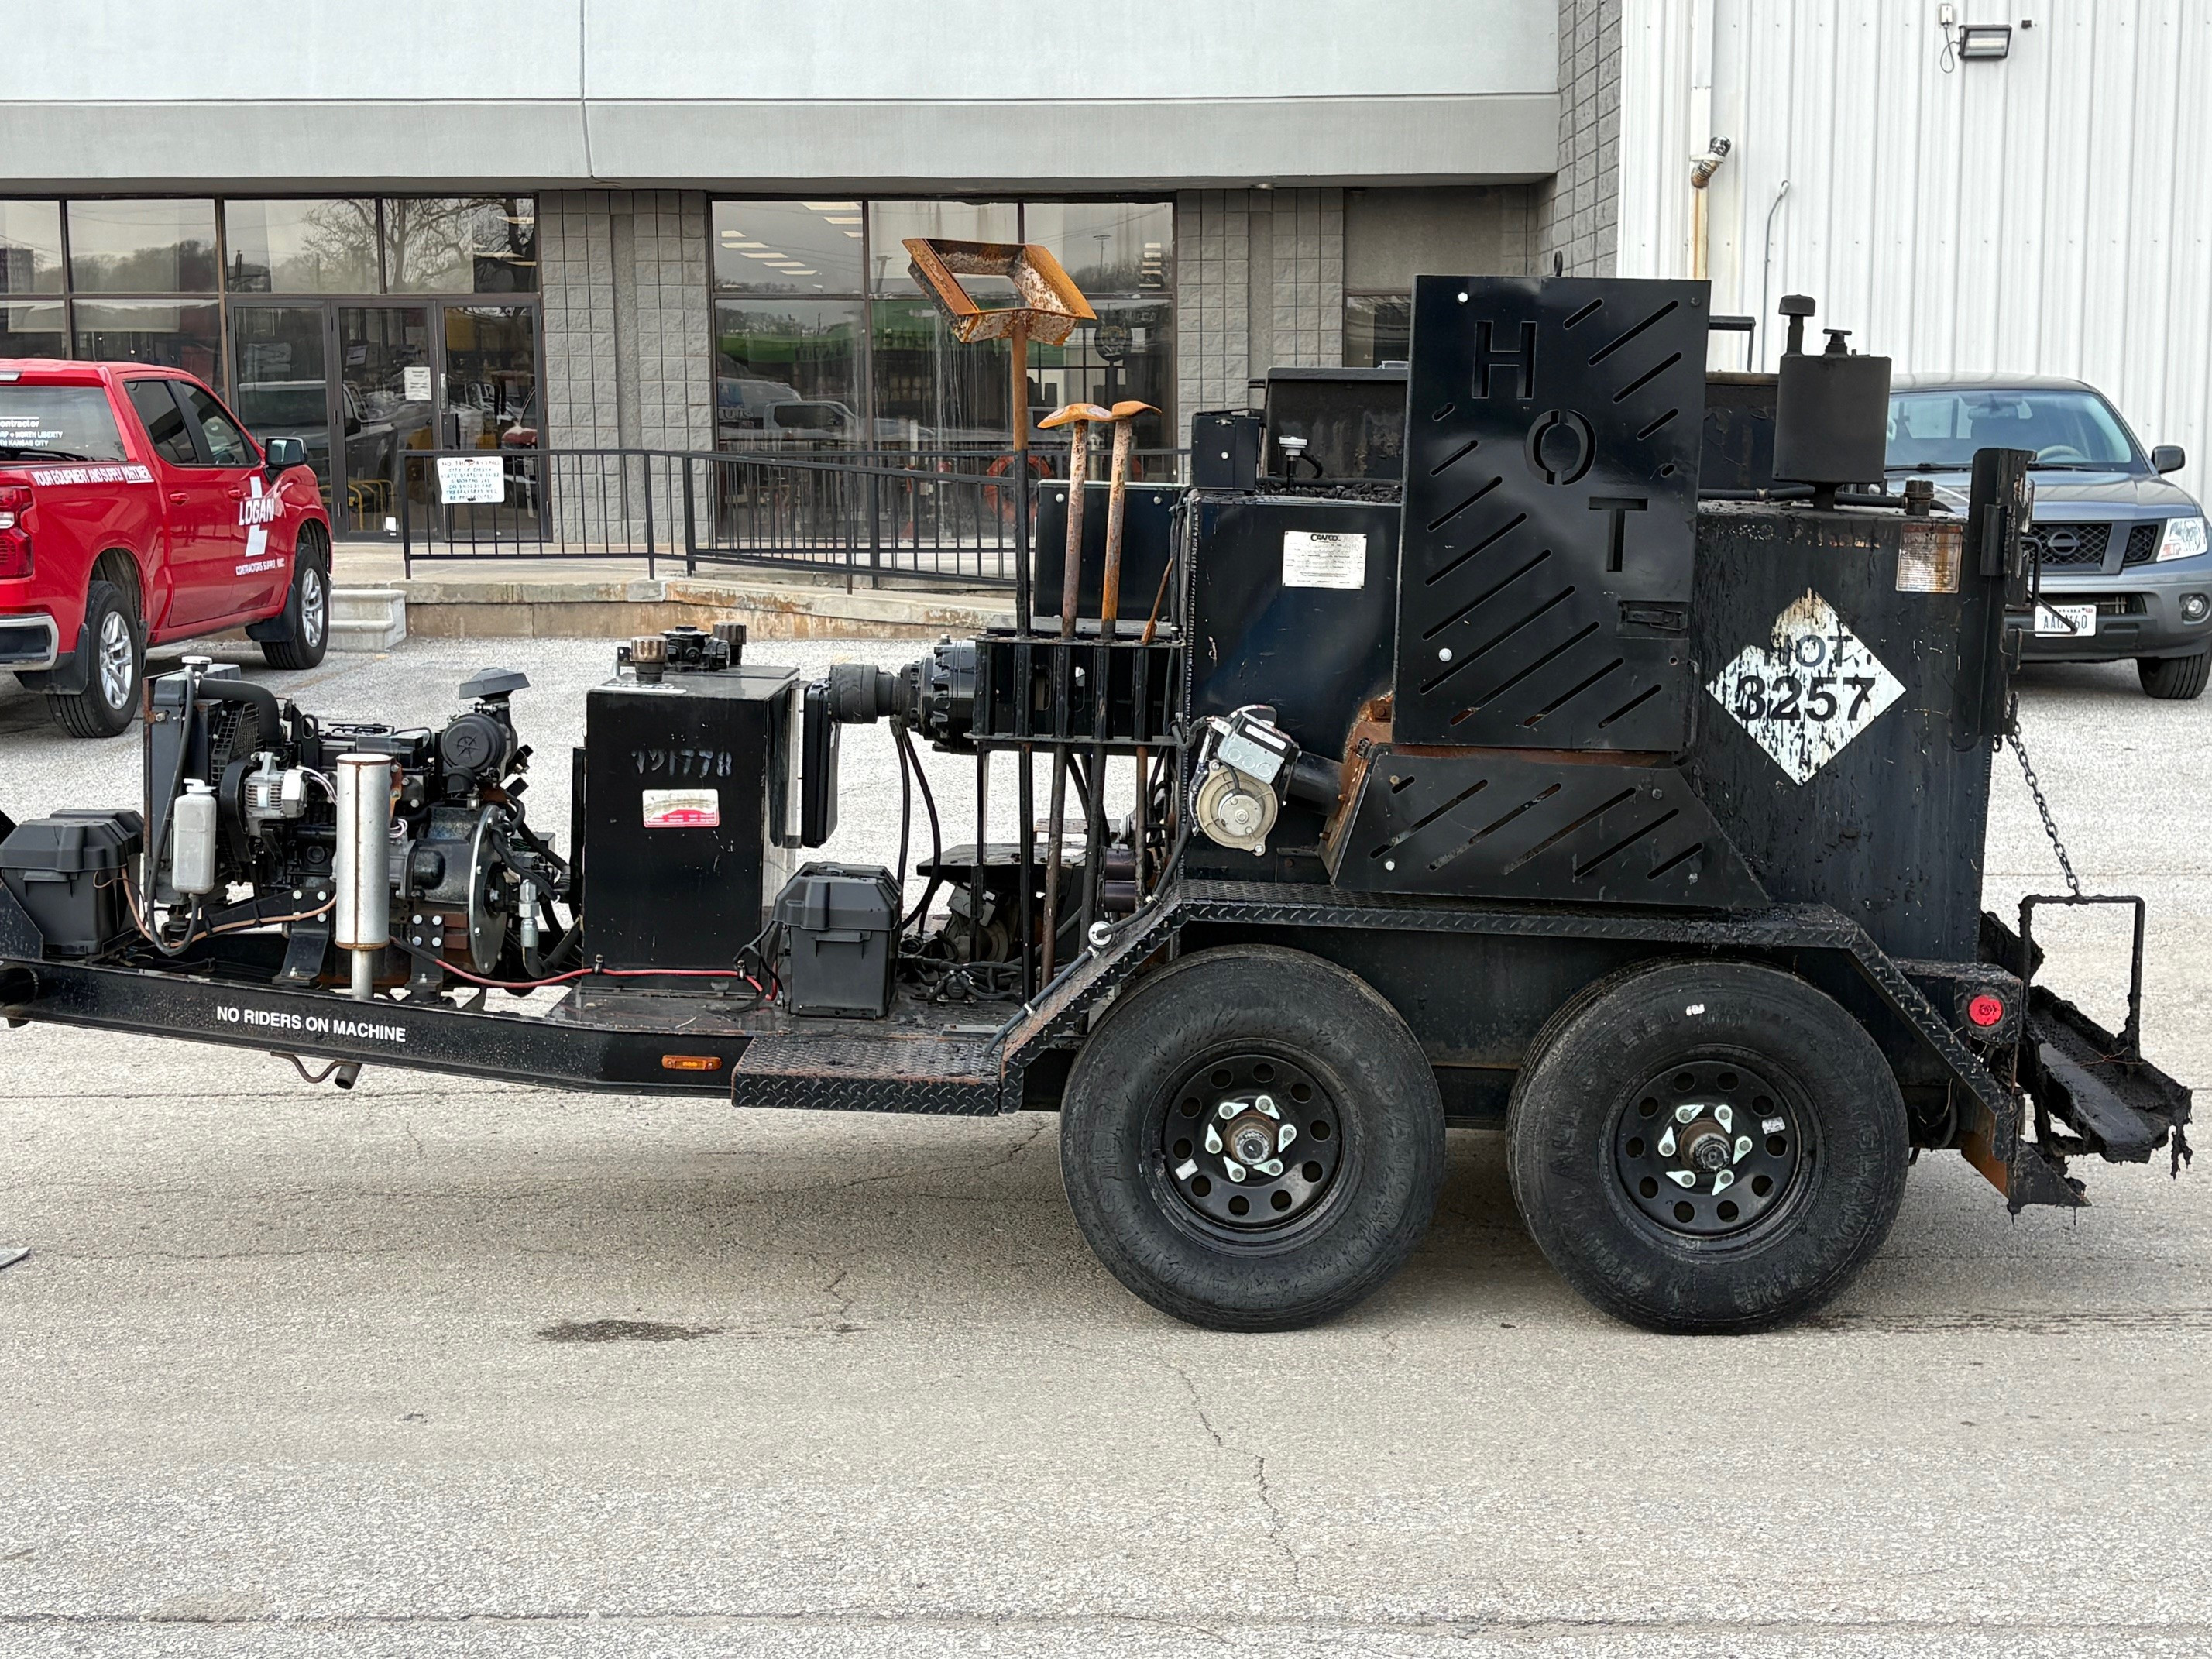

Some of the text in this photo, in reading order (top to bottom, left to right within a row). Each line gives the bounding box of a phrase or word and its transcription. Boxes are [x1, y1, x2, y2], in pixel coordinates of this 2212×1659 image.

[239, 498, 275, 526] LOGAN
[216, 1006, 407, 1042] NO RIDERS ON MACHINE
